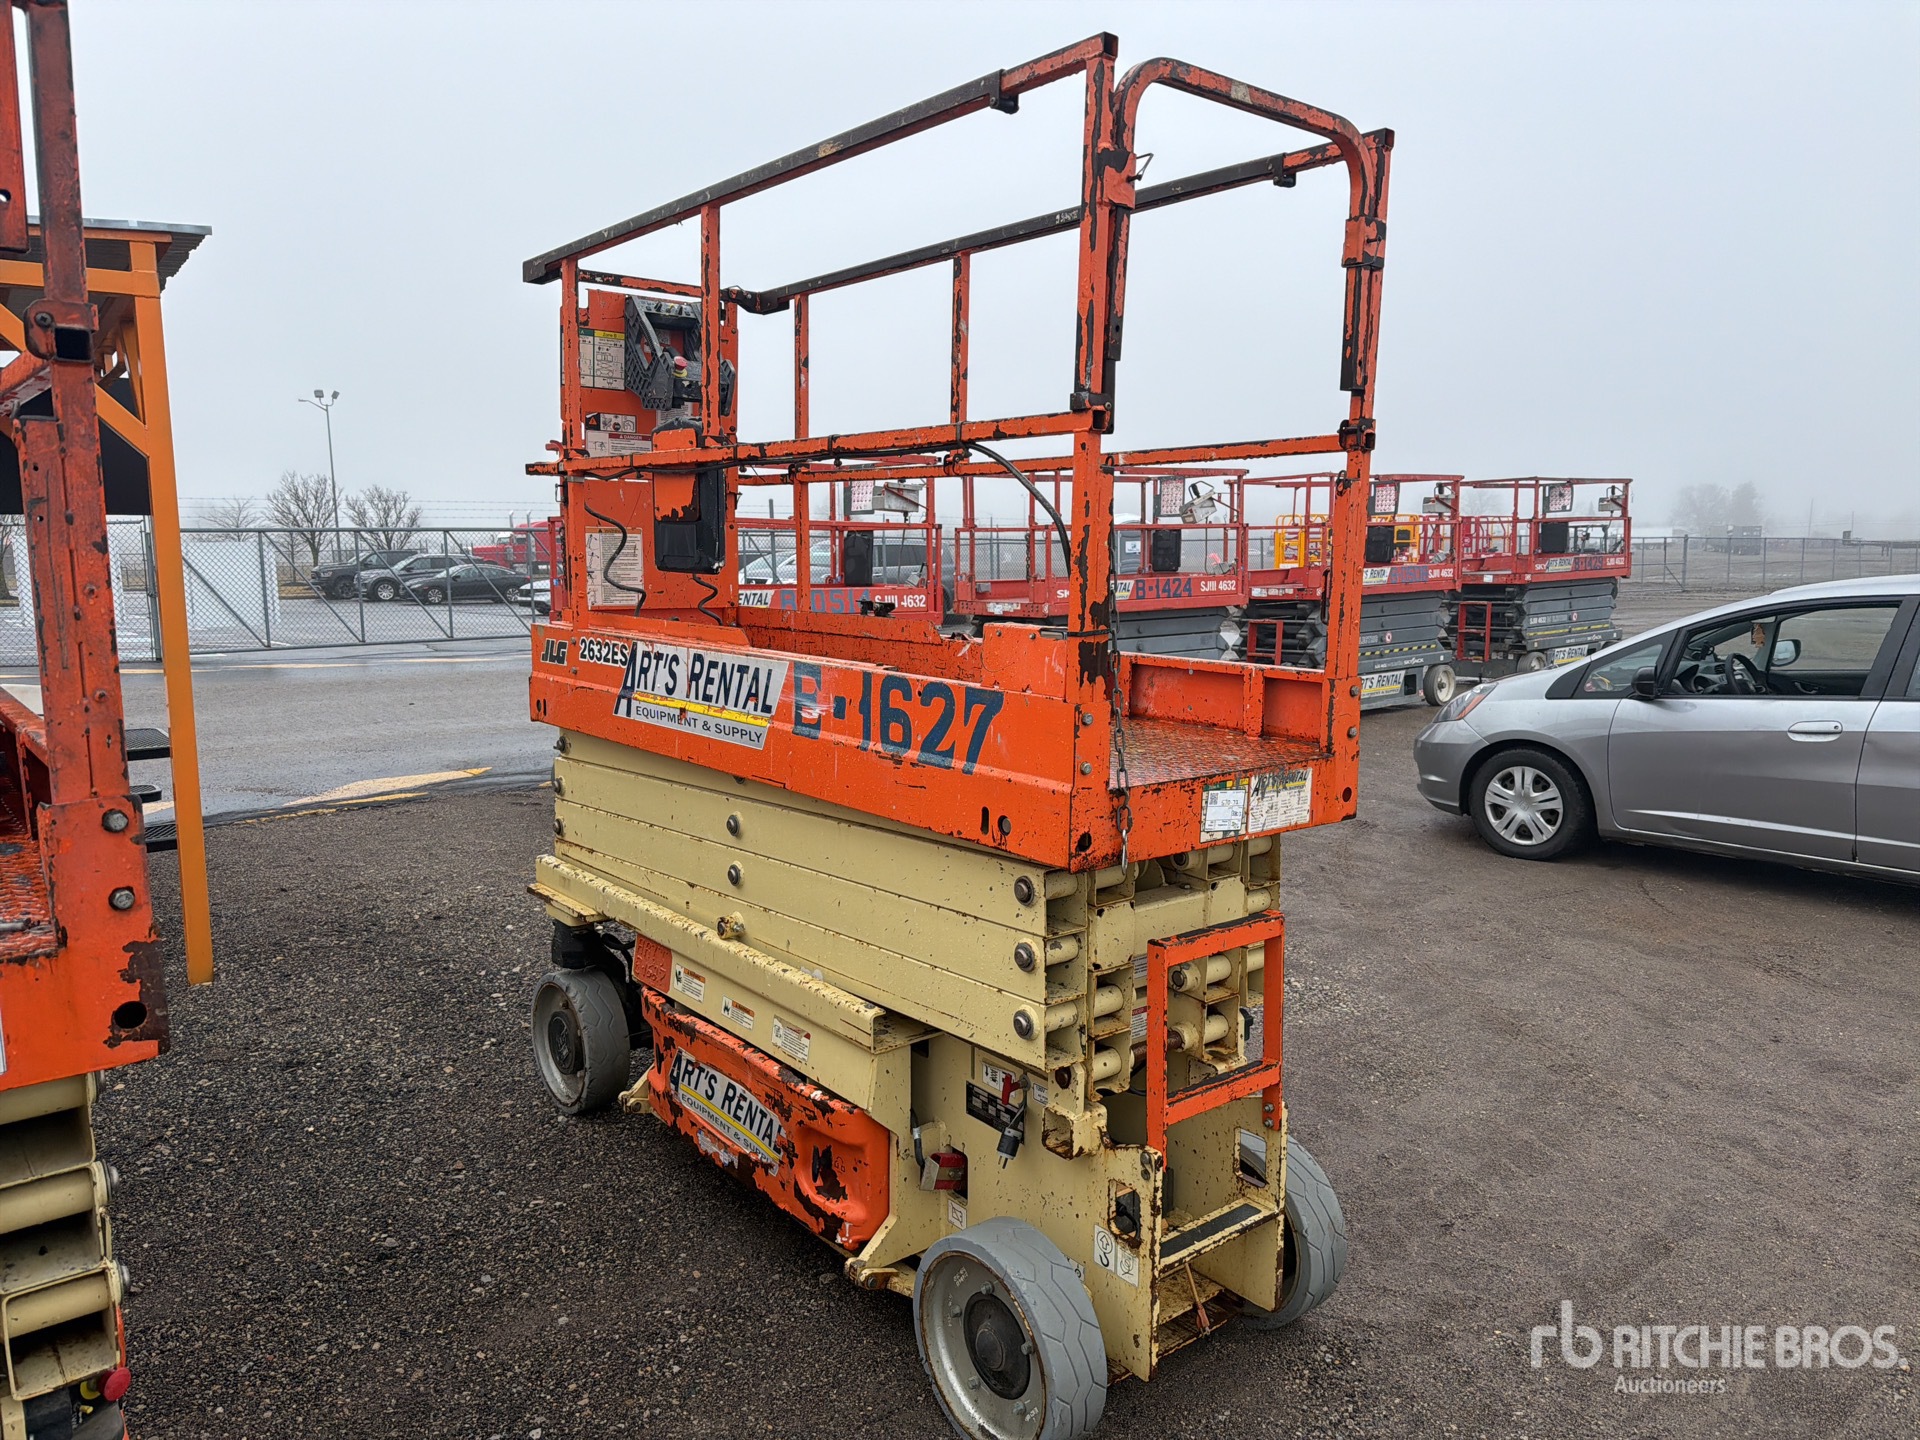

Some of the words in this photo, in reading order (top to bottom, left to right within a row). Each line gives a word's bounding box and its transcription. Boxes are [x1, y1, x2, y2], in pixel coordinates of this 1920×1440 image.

[738, 592, 770, 606] ENTAL
[1135, 577, 1193, 600] B-1424
[1218, 580, 1237, 591] 4632
[541, 638, 567, 665] JLG
[579, 637, 629, 667] 2632ES
[614, 642, 680, 717] ART'S
[686, 653, 773, 714] RENTAL
[1361, 677, 1375, 689] RT'S
[1375, 673, 1402, 688] RENTAL
[635, 705, 699, 729] EQUIPMENT
[702, 721, 712, 732] &
[715, 723, 763, 743] SUPPLY
[792, 661, 1004, 775] E-1627
[669, 1050, 718, 1101] ART'S
[681, 1094, 732, 1133] EQUIPMENT
[733, 1131, 741, 1140] &
